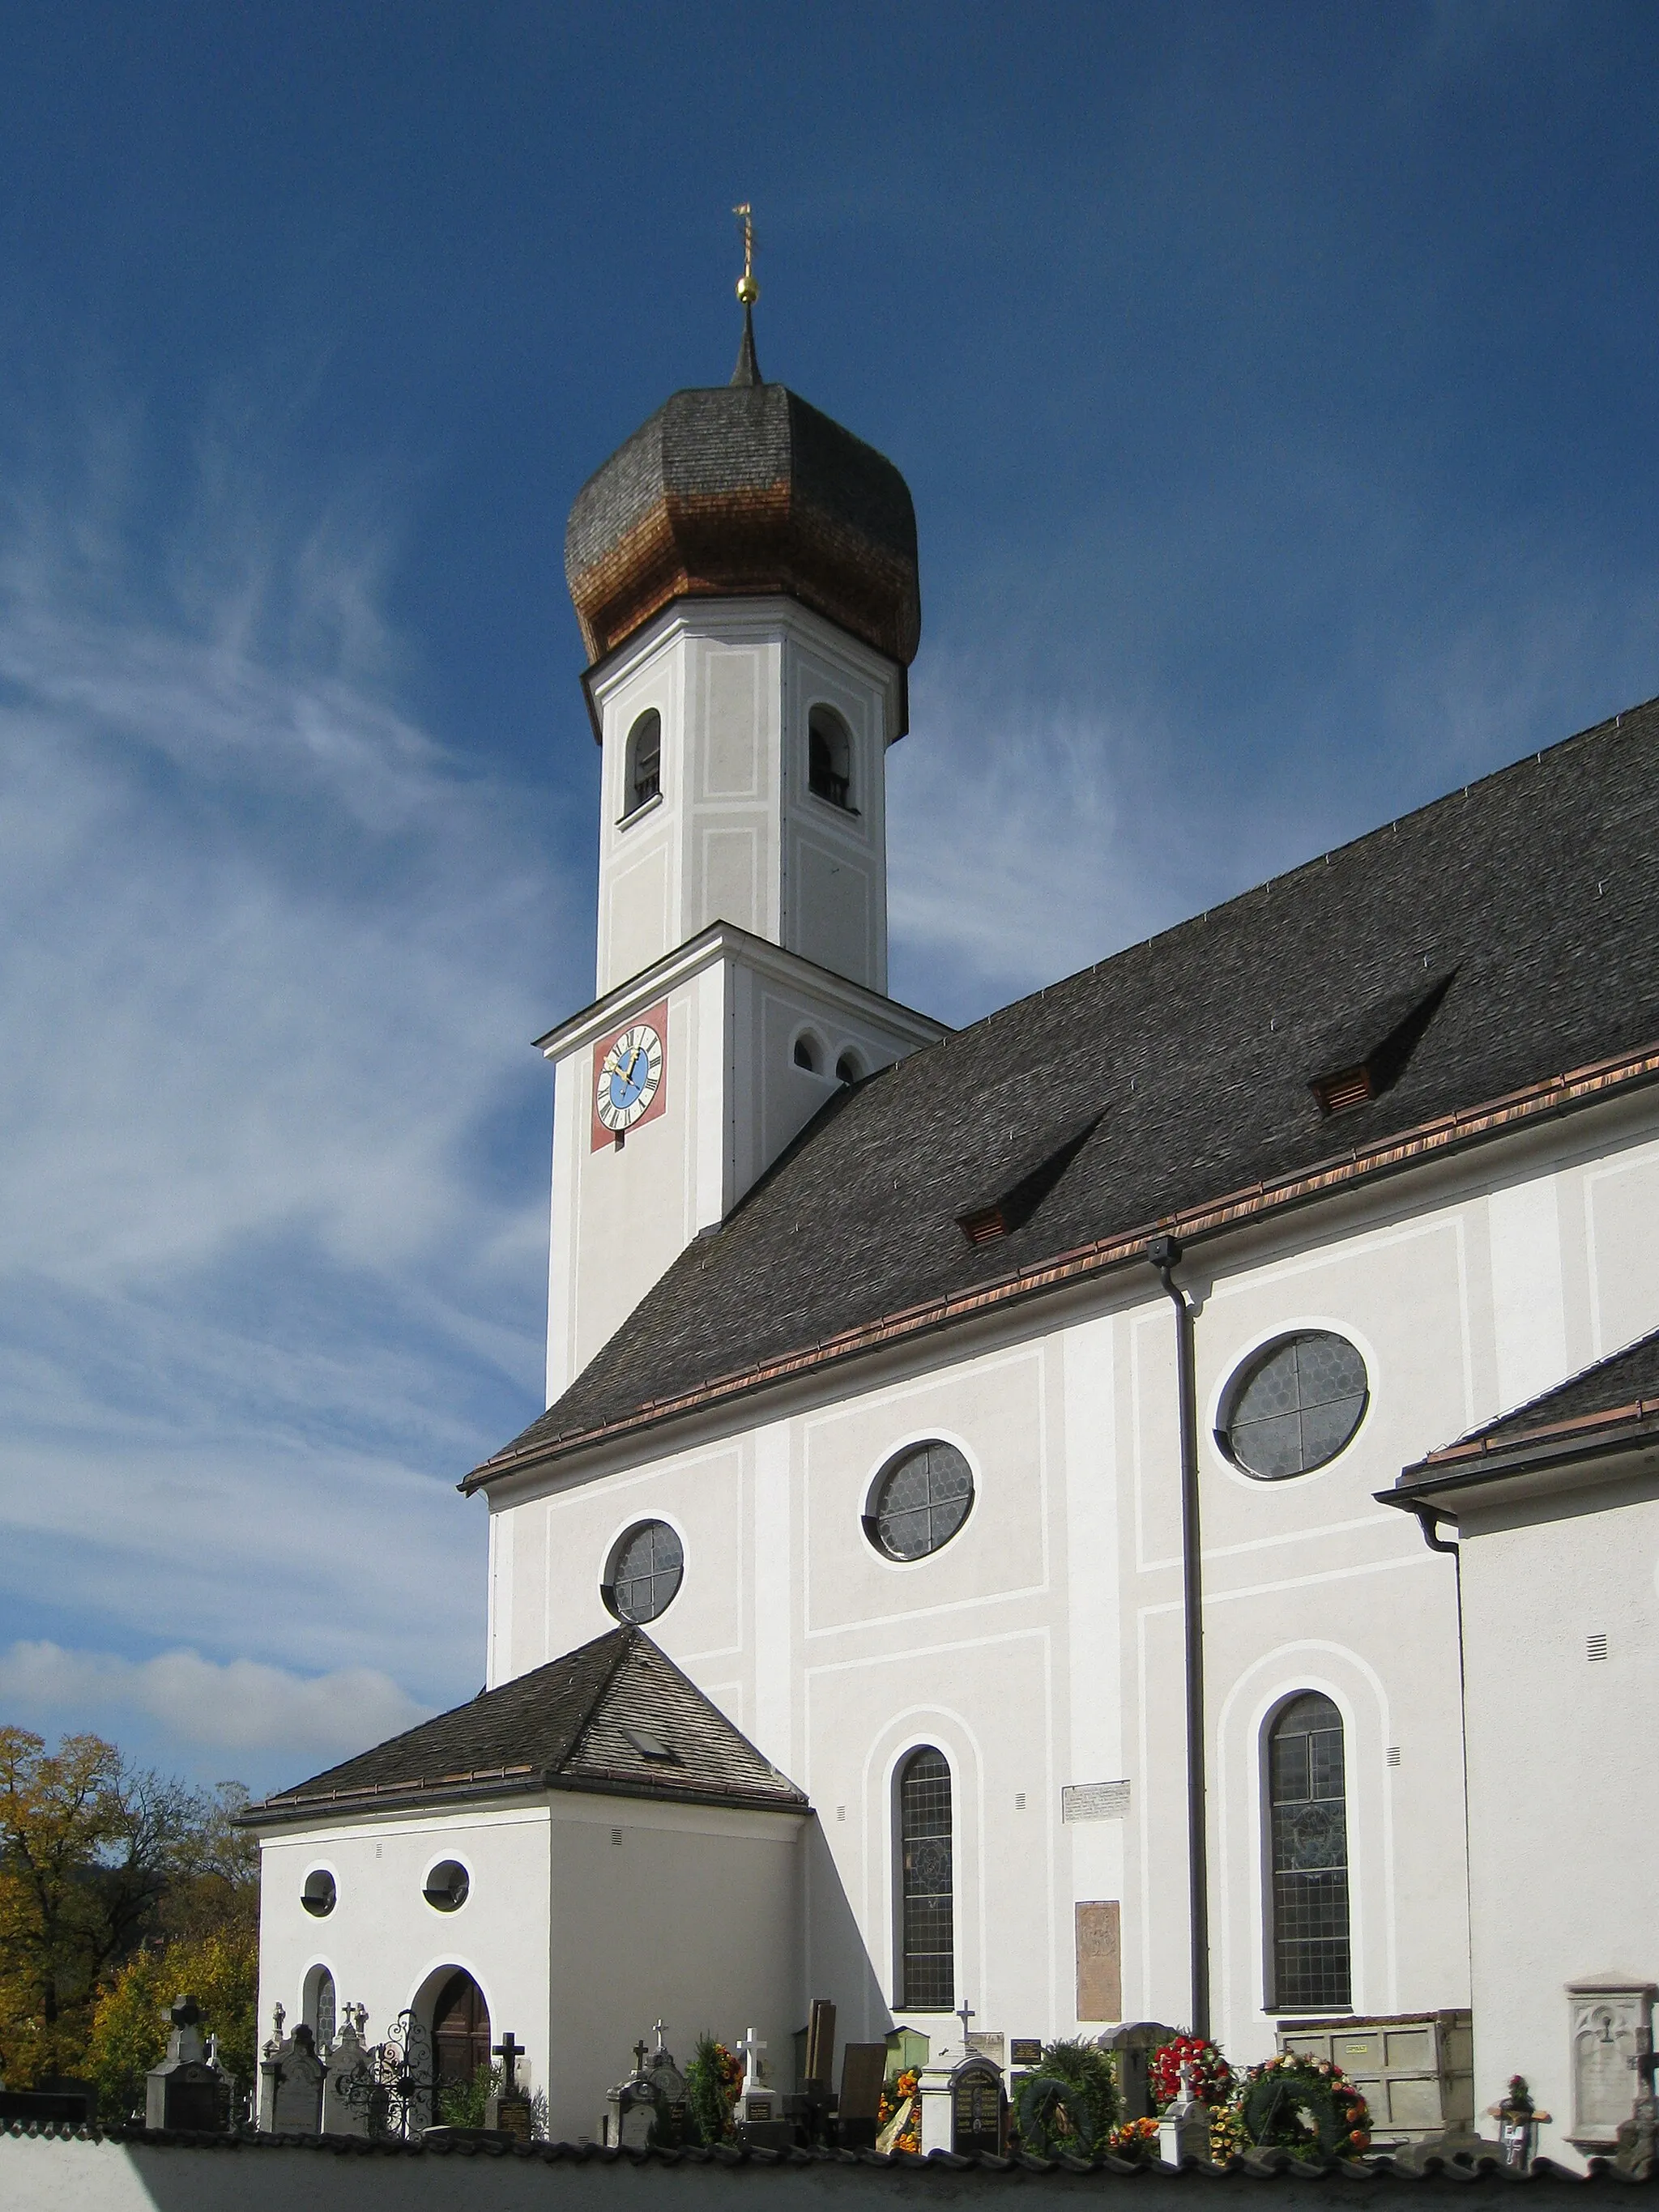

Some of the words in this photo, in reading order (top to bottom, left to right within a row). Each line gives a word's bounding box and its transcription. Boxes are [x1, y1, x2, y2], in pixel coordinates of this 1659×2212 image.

[646, 1036, 658, 1053] II
[649, 1055, 661, 1069] III
[645, 1078, 658, 1091] IIII
[638, 1098, 646, 1112] V
